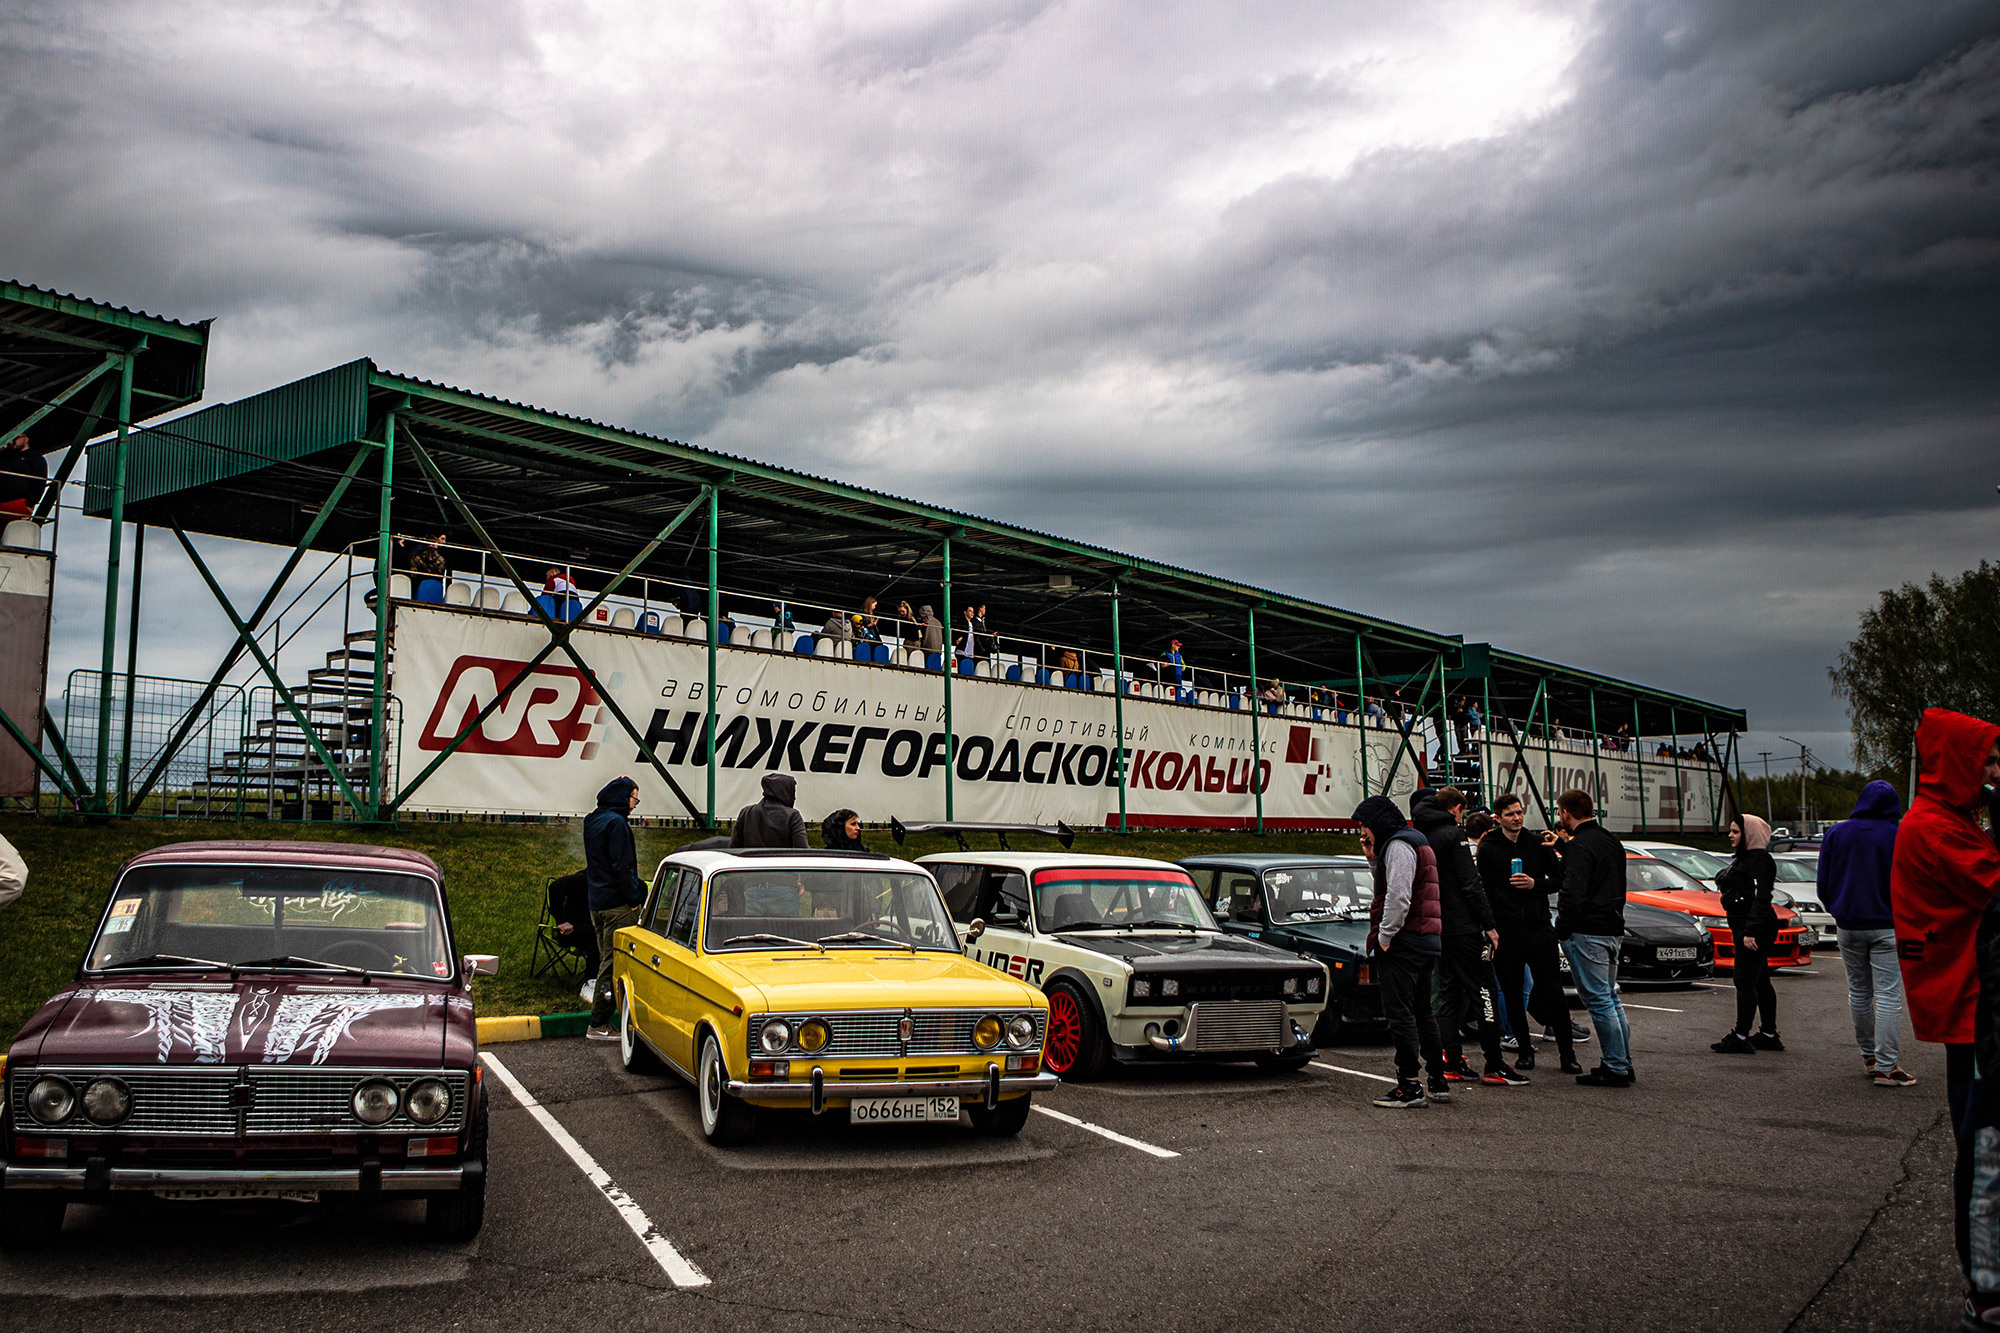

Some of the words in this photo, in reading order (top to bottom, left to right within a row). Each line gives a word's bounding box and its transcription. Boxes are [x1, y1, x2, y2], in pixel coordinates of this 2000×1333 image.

[661, 679, 947, 723] автомобильный
[1006, 714, 1149, 742] спортивный
[1189, 733, 1277, 753] комплекс
[857, 1100, 925, 1120] О666НЕ
[929, 1098, 955, 1113] 152
